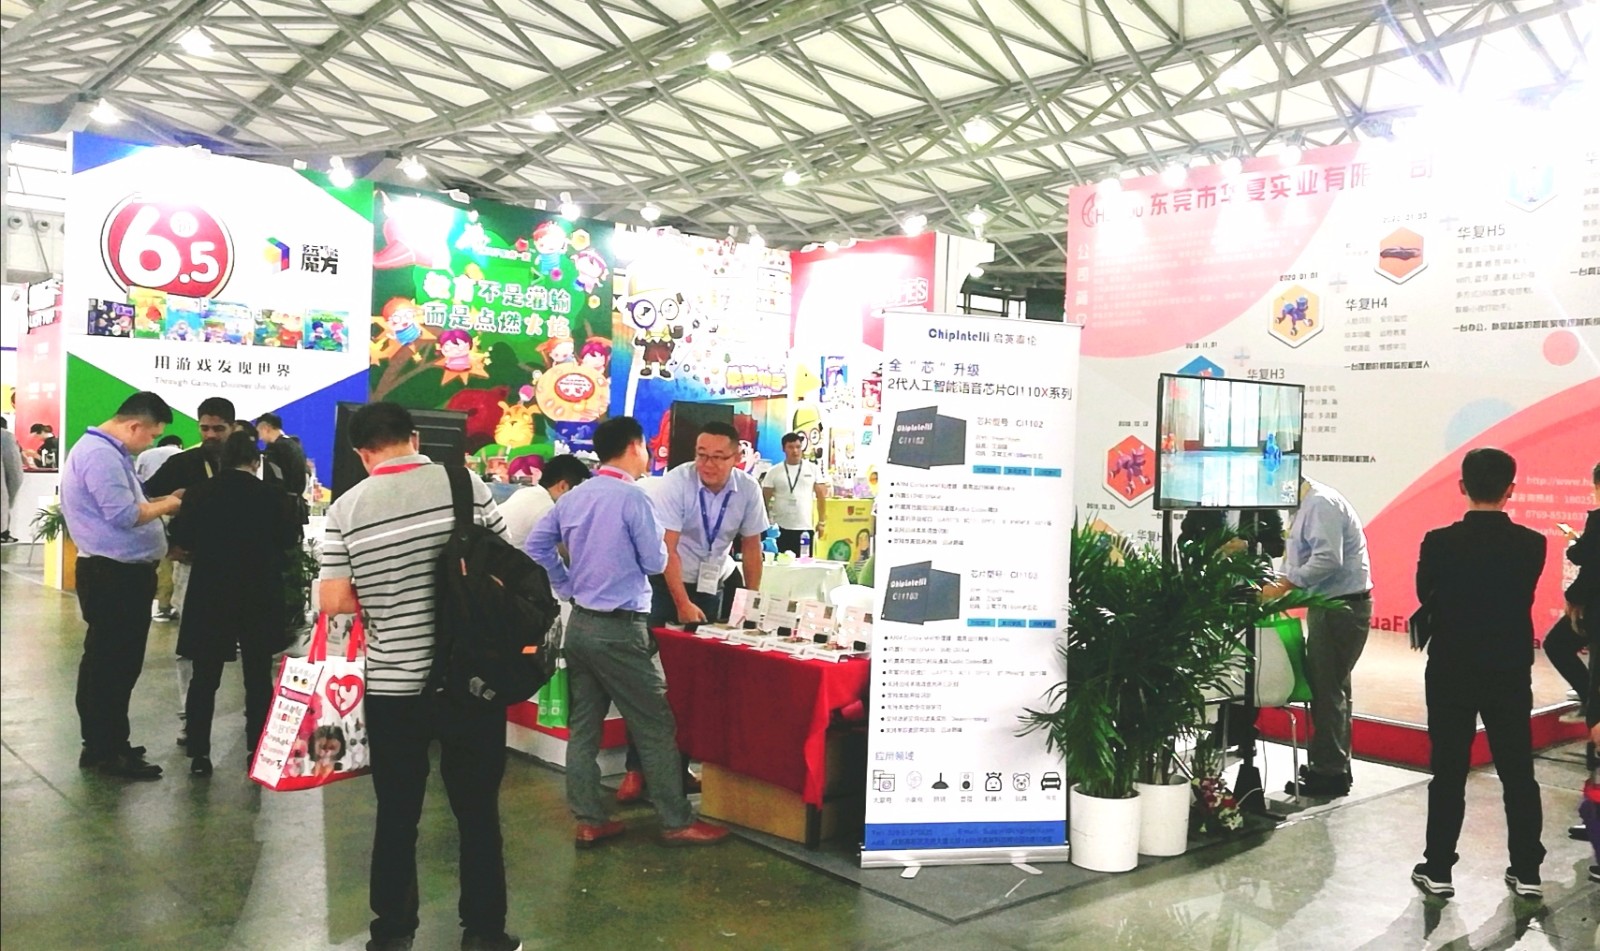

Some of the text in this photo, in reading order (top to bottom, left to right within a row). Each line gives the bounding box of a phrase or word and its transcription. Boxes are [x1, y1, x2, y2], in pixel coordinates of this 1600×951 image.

[1457, 225, 1506, 240] 华复H5
[423, 270, 571, 313] 不是灌输
[1345, 297, 1388, 312] 华复H4
[424, 301, 571, 339] 而是点燃火焰
[154, 355, 290, 377] 用游戏发现世界
[1247, 368, 1285, 382] 华复H3
[1526, 476, 1595, 488] http://www.h
